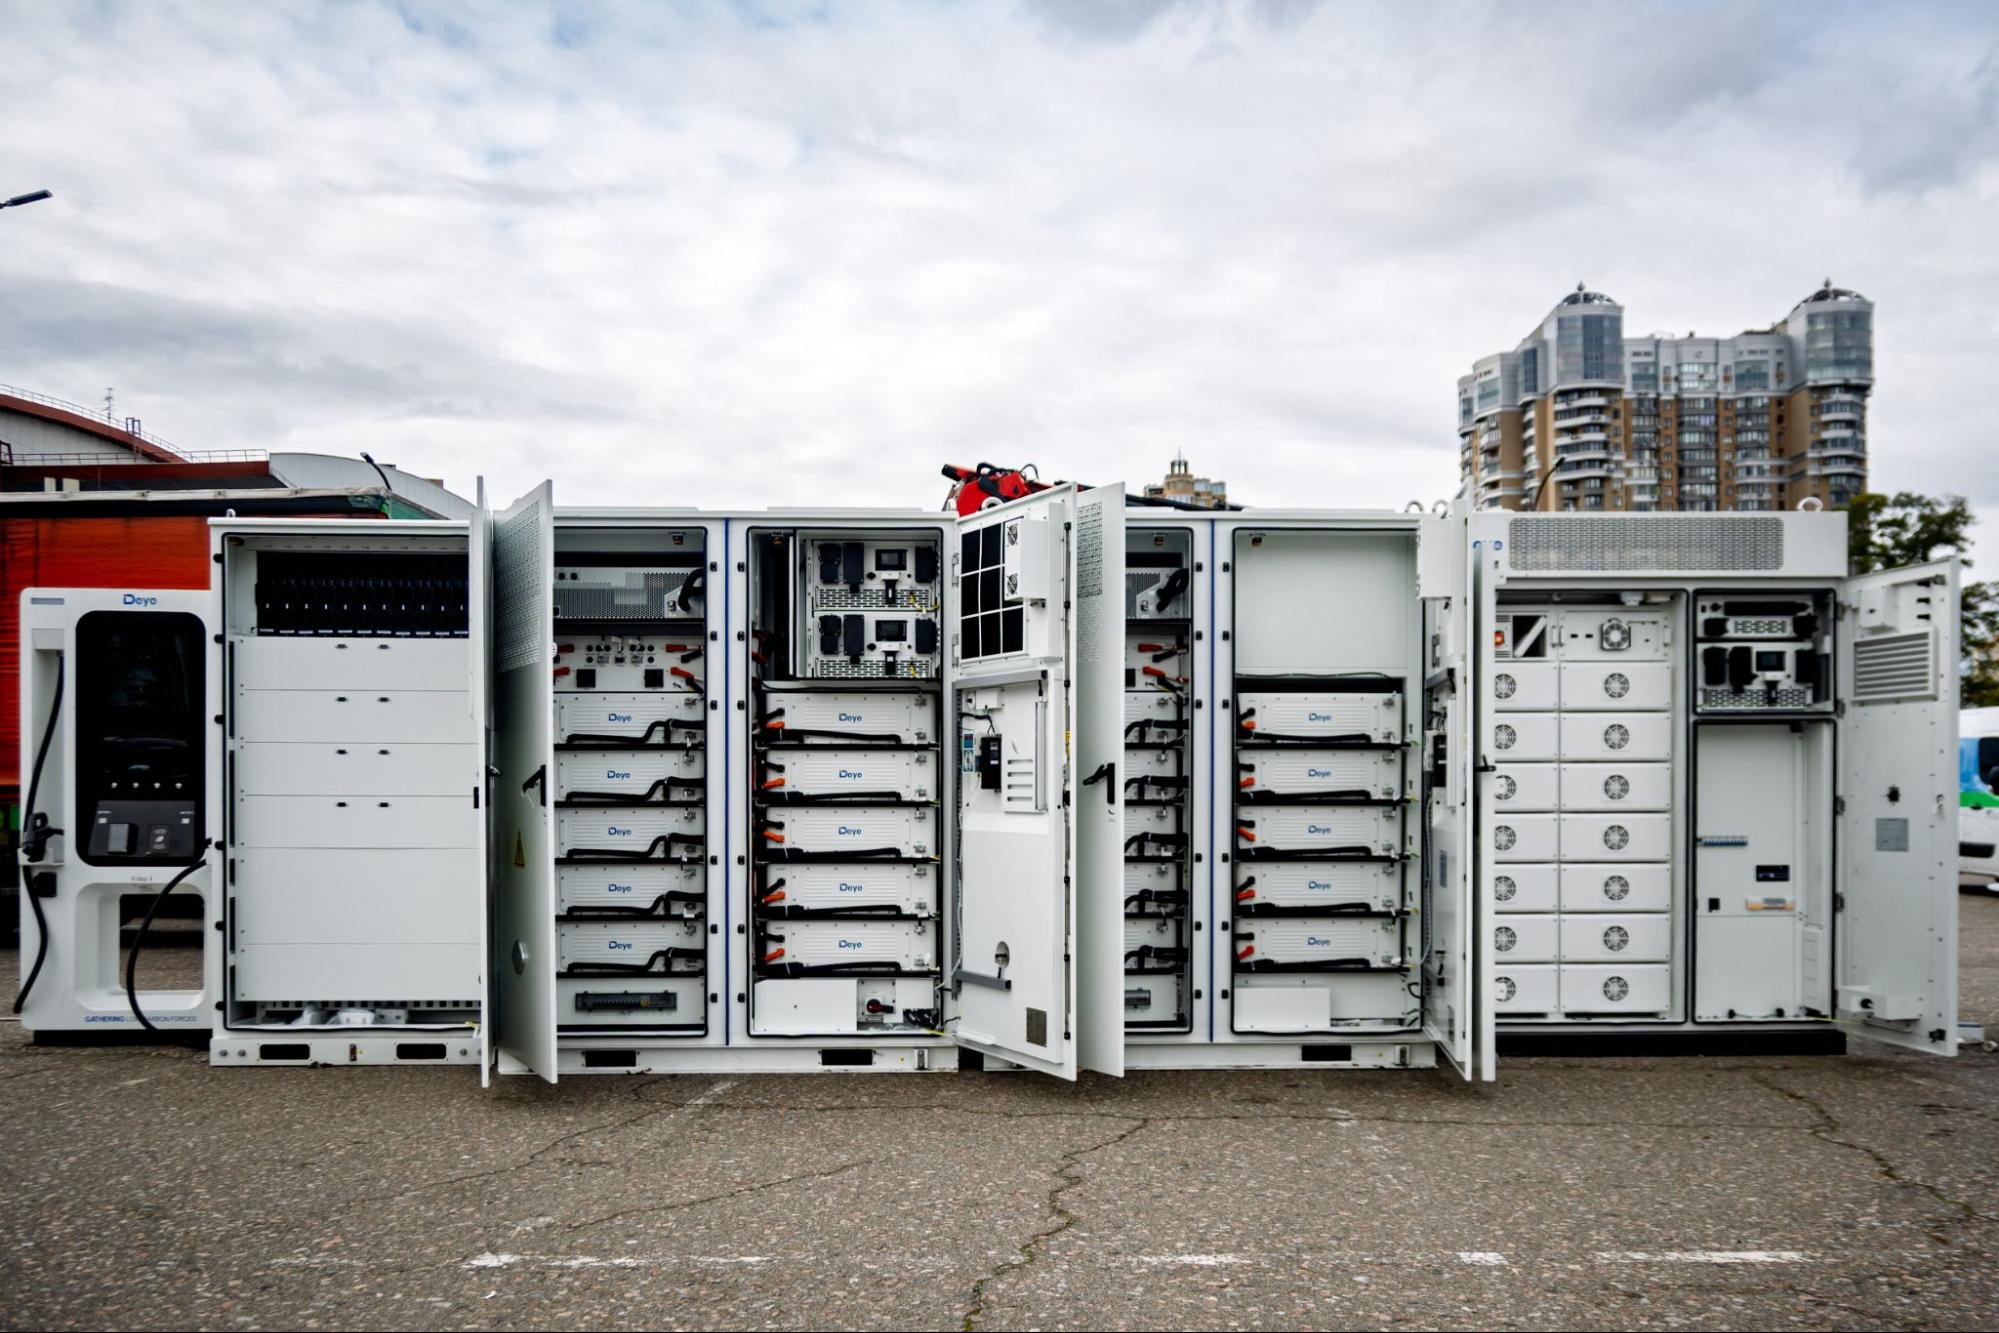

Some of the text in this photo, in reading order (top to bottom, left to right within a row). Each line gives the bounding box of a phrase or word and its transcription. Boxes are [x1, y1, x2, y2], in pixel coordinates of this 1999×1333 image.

[123, 593, 157, 607] Deye
[608, 713, 632, 723] Deye
[839, 713, 862, 723] Deye
[1308, 713, 1332, 722] Deye
[607, 770, 631, 780] Deye
[839, 770, 862, 780] Deye
[1308, 769, 1332, 778] Deye
[608, 826, 632, 837] Deye
[839, 826, 862, 836] Deye
[1308, 825, 1331, 835] Deye
[608, 884, 632, 893] Deye
[840, 883, 862, 893] Deye
[1308, 881, 1332, 890] Deye
[608, 940, 632, 951] Deye
[839, 940, 862, 950] Deye
[1308, 937, 1331, 947] Deye
